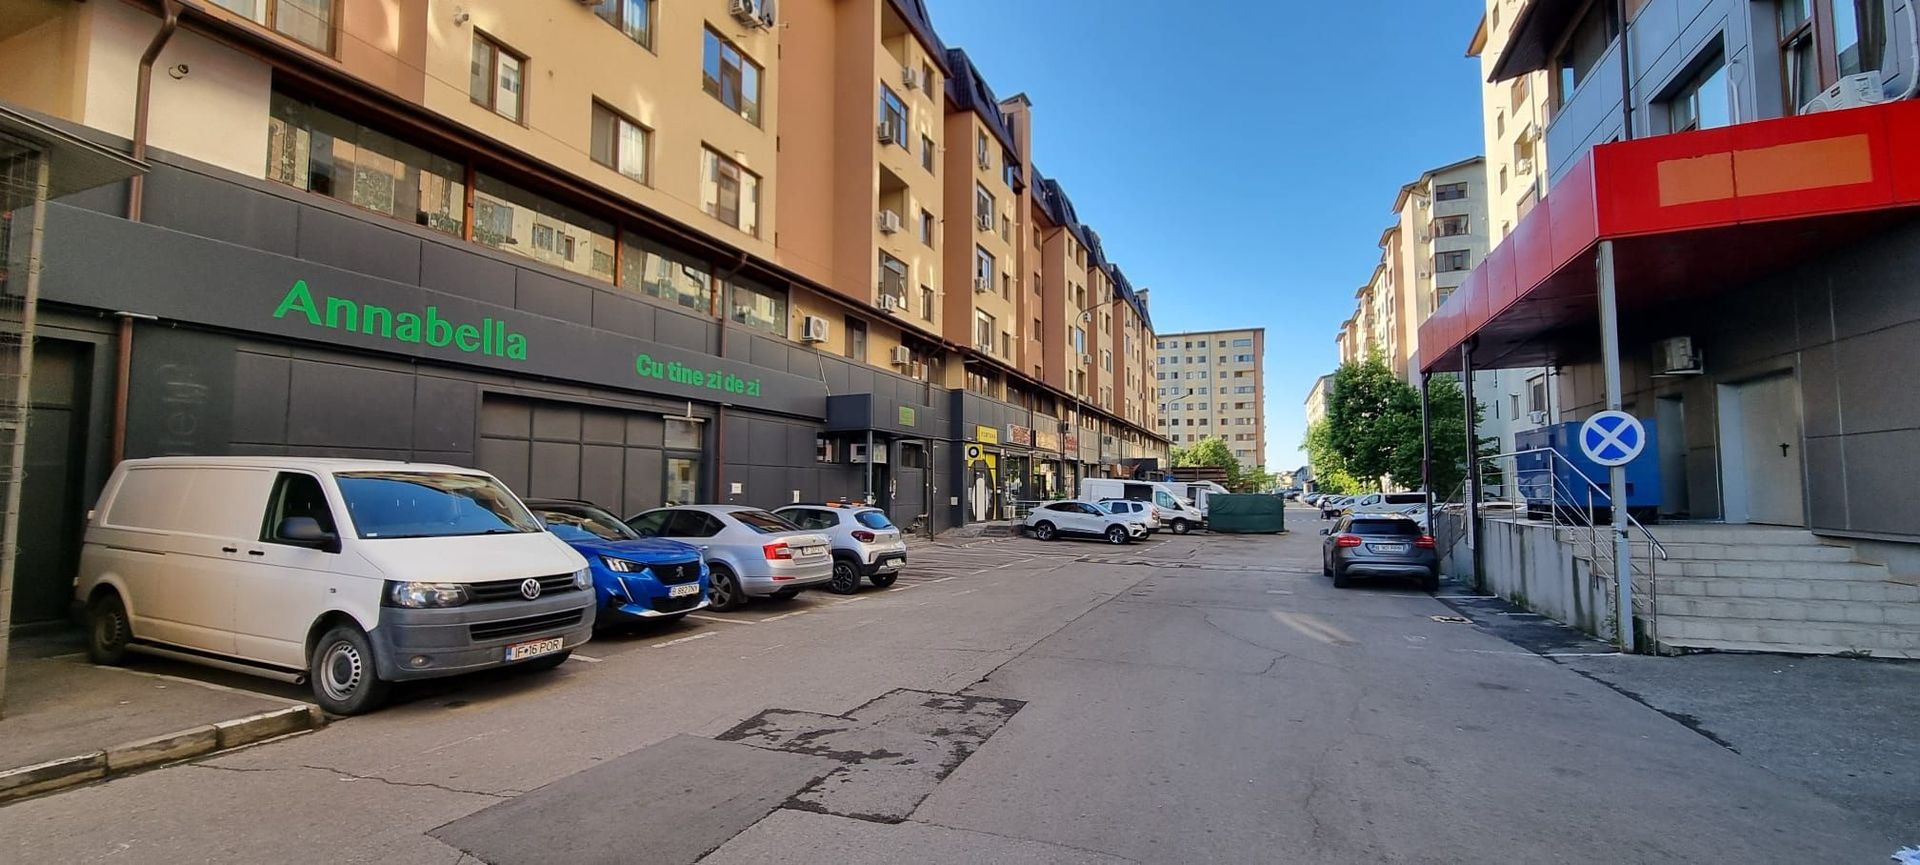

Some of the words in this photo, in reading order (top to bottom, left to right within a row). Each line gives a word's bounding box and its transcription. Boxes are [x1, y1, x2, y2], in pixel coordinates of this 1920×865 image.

[273, 279, 528, 361] Annabella
[636, 354, 664, 379] Cu
[667, 361, 704, 386] tine
[706, 370, 721, 389] zi
[725, 373, 744, 394] de
[747, 379, 760, 397] zi
[540, 640, 559, 653] POR
